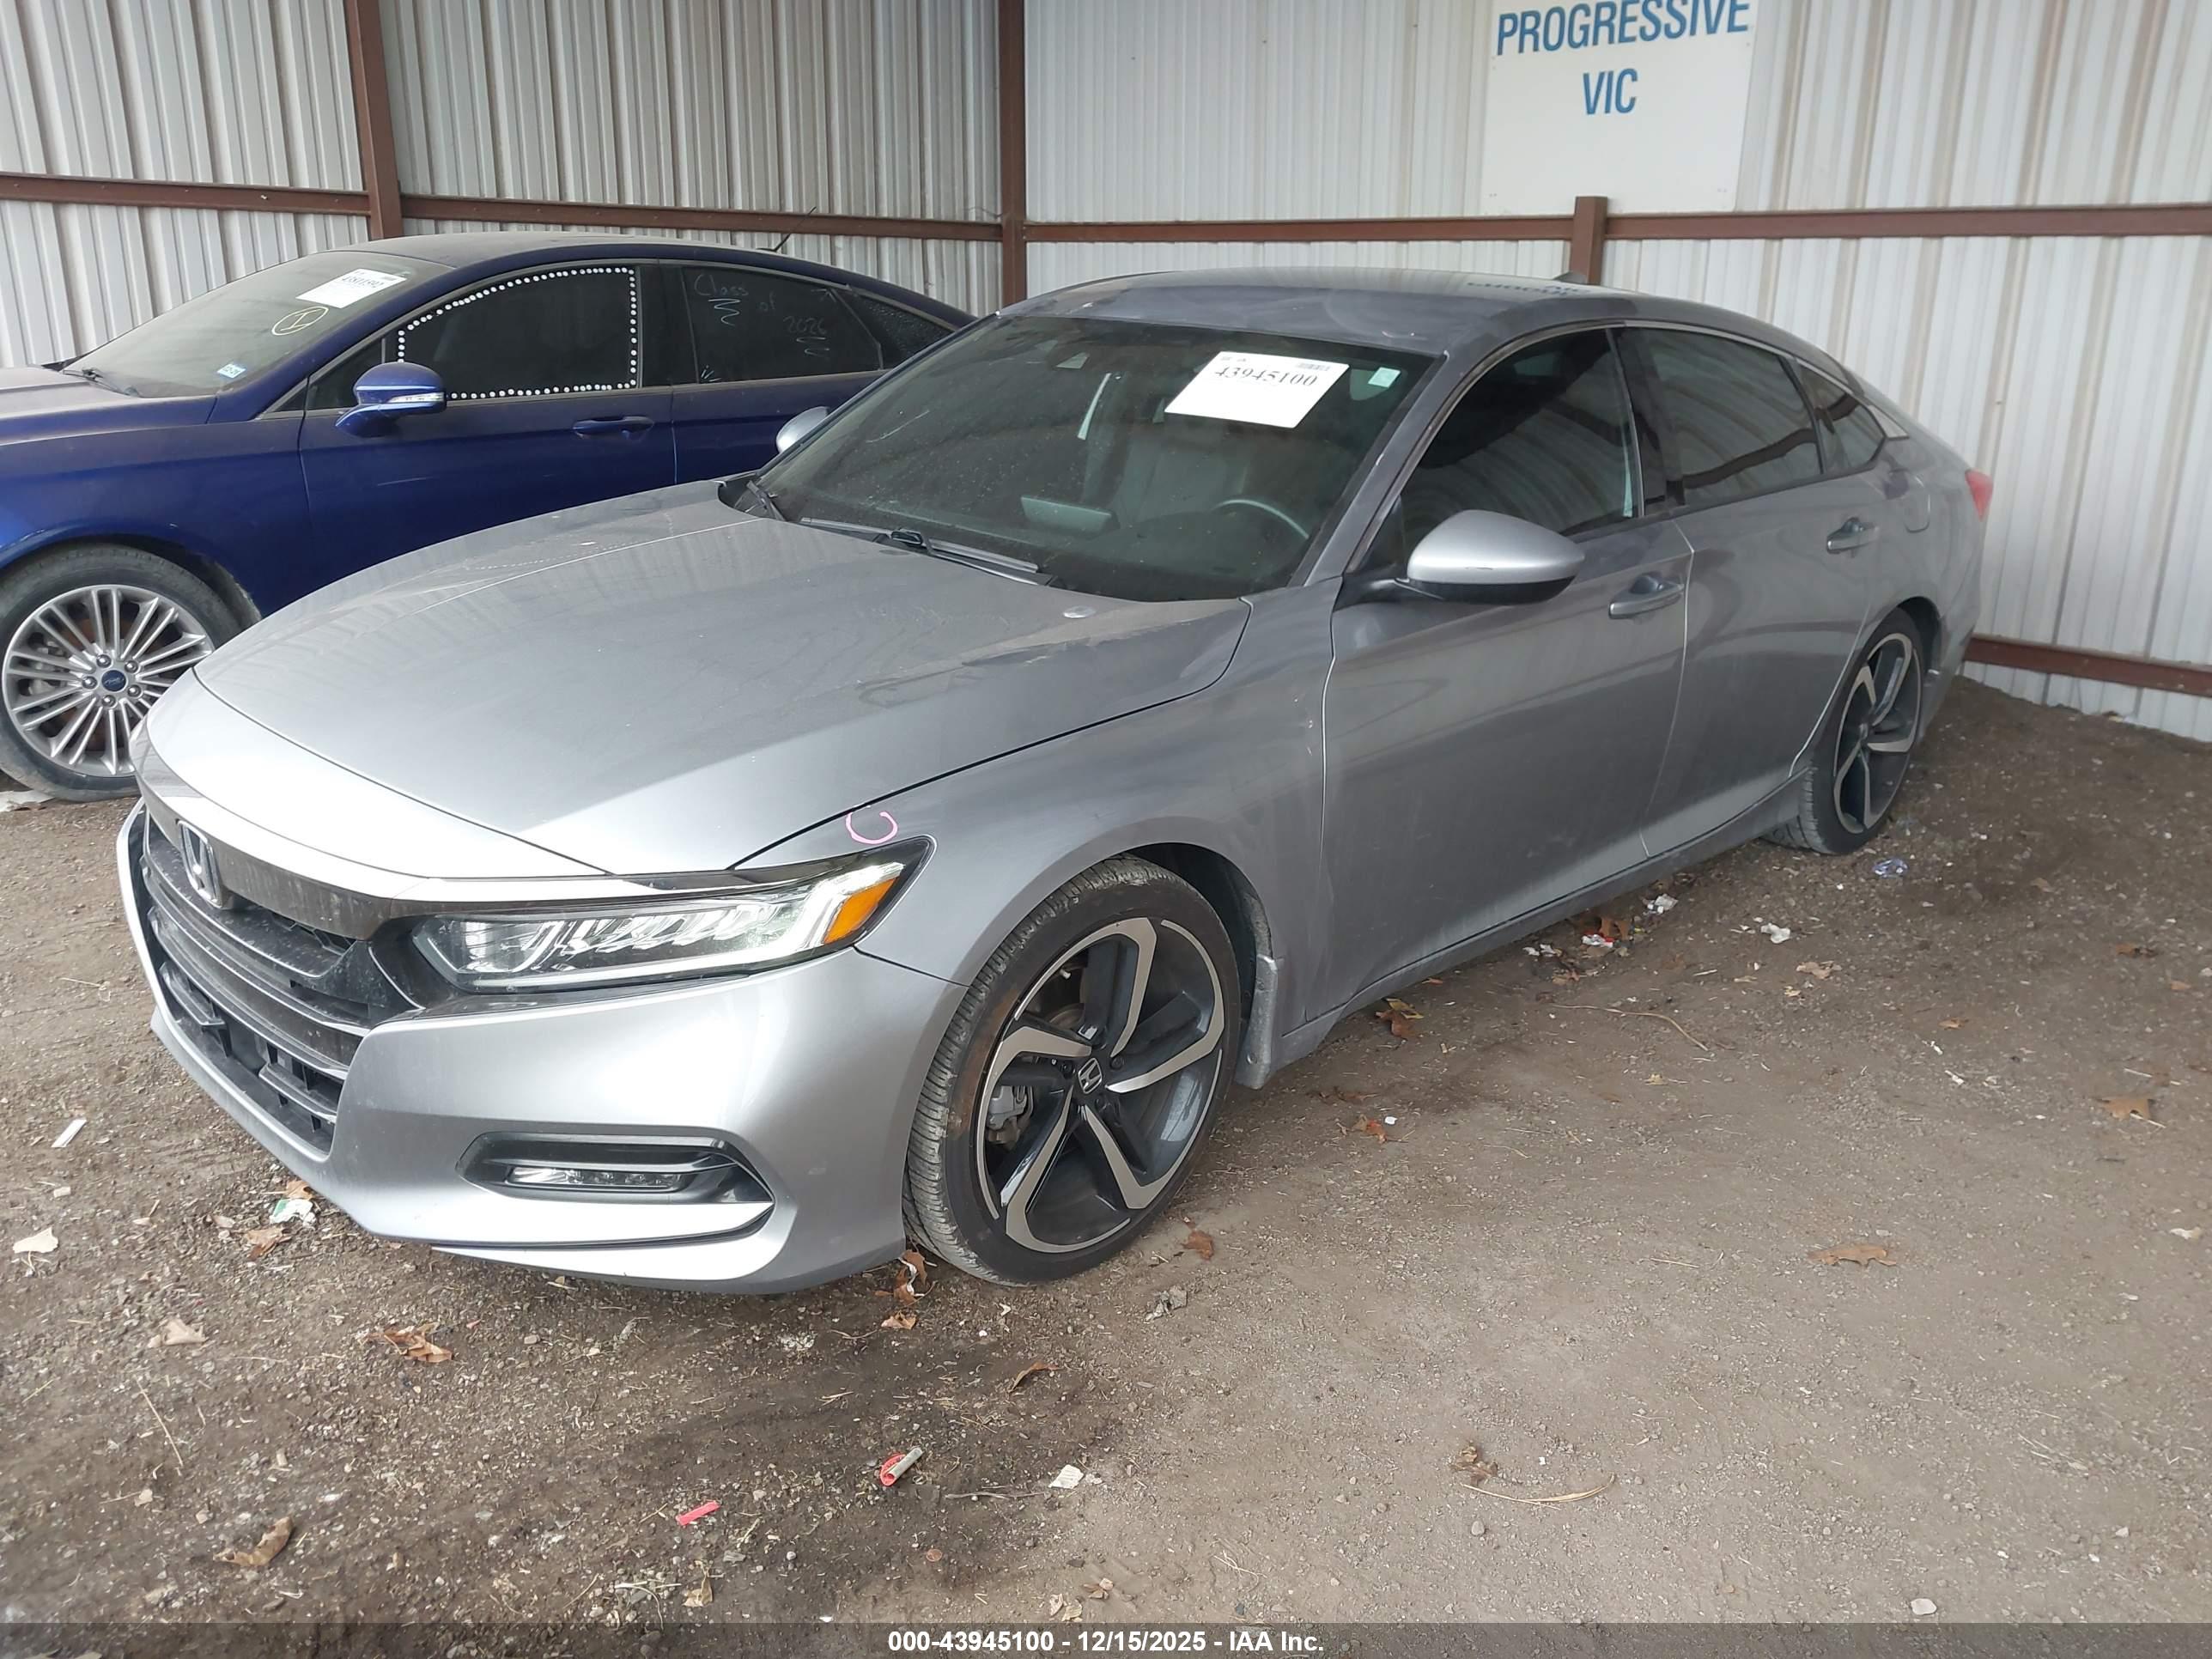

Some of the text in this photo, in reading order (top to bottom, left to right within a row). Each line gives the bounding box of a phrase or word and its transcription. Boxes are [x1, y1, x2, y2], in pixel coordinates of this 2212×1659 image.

[1497, 0, 1752, 56] PROGRESSIVE
[1583, 68, 1638, 115] VIC
[1215, 366, 1318, 386] 43945100
